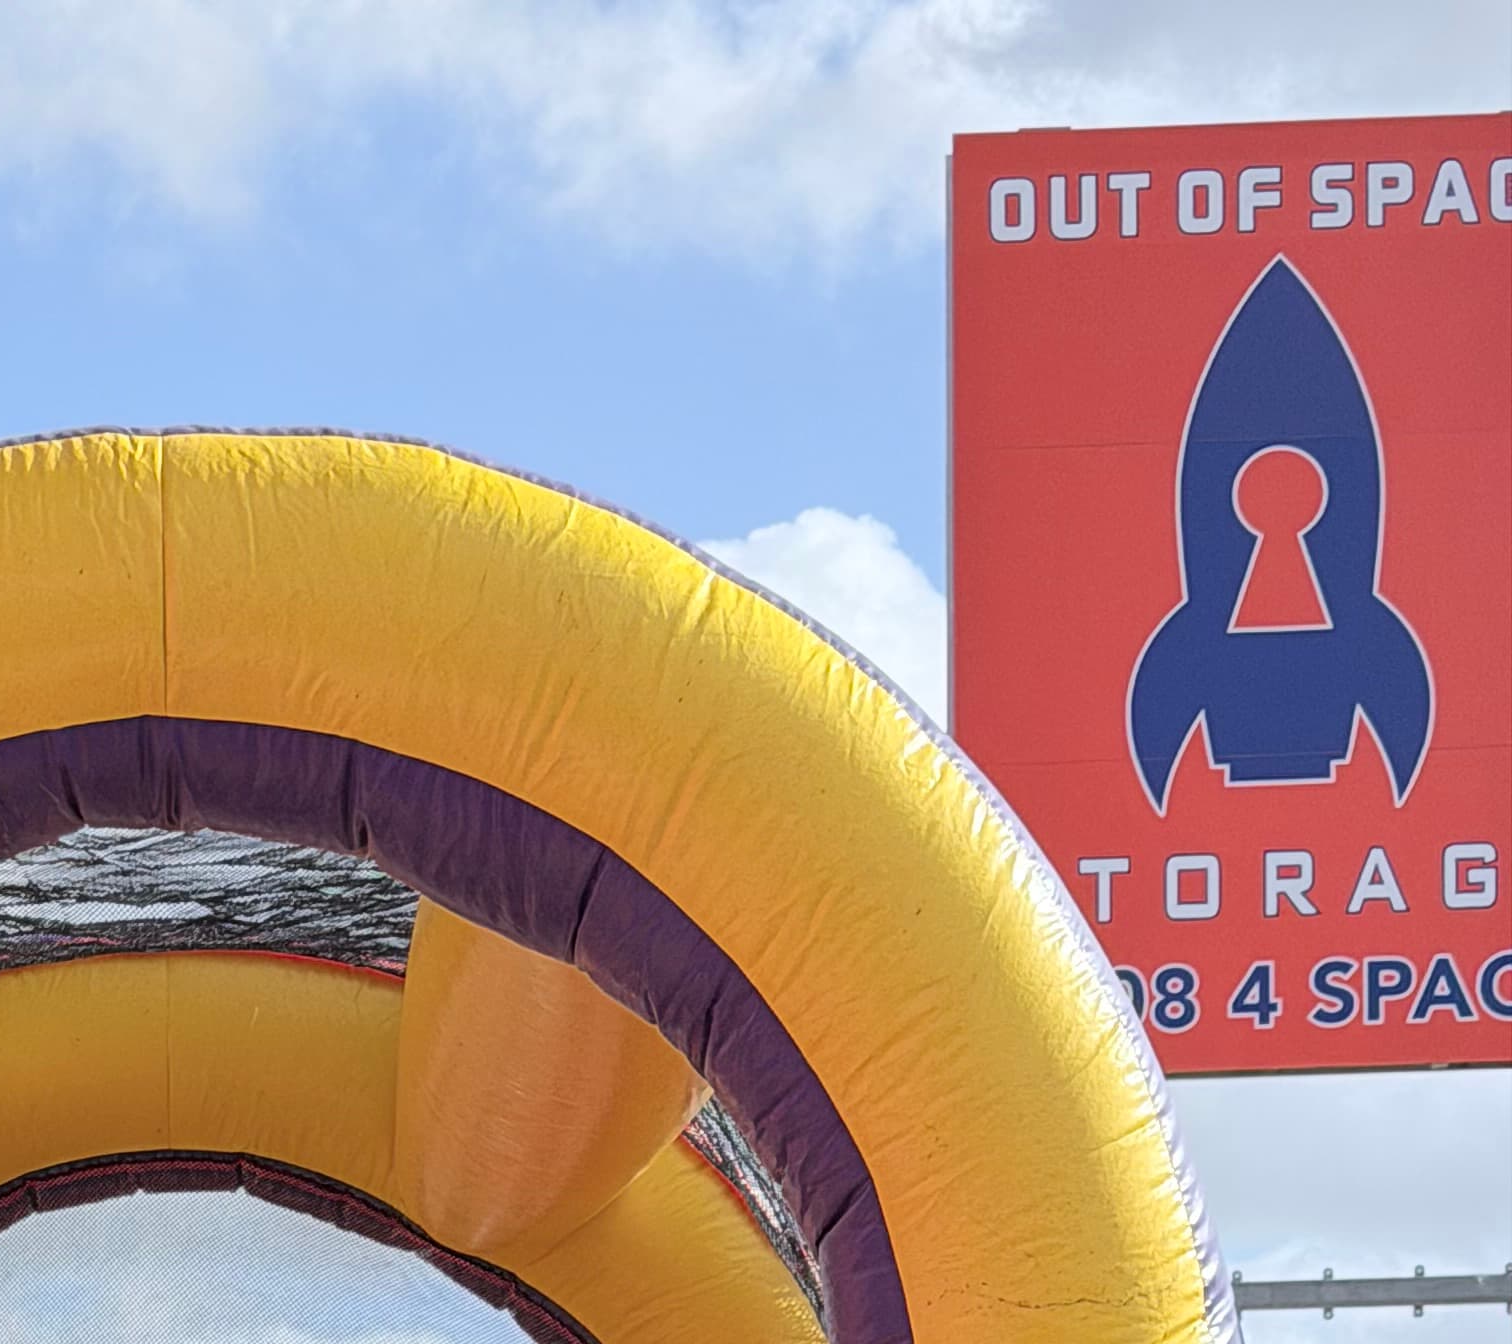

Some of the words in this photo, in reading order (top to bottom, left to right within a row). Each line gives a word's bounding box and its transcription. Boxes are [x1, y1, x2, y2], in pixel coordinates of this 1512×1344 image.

[988, 171, 1152, 243] OUT
[1177, 165, 1283, 236] OF
[1227, 959, 1283, 1031] 4
